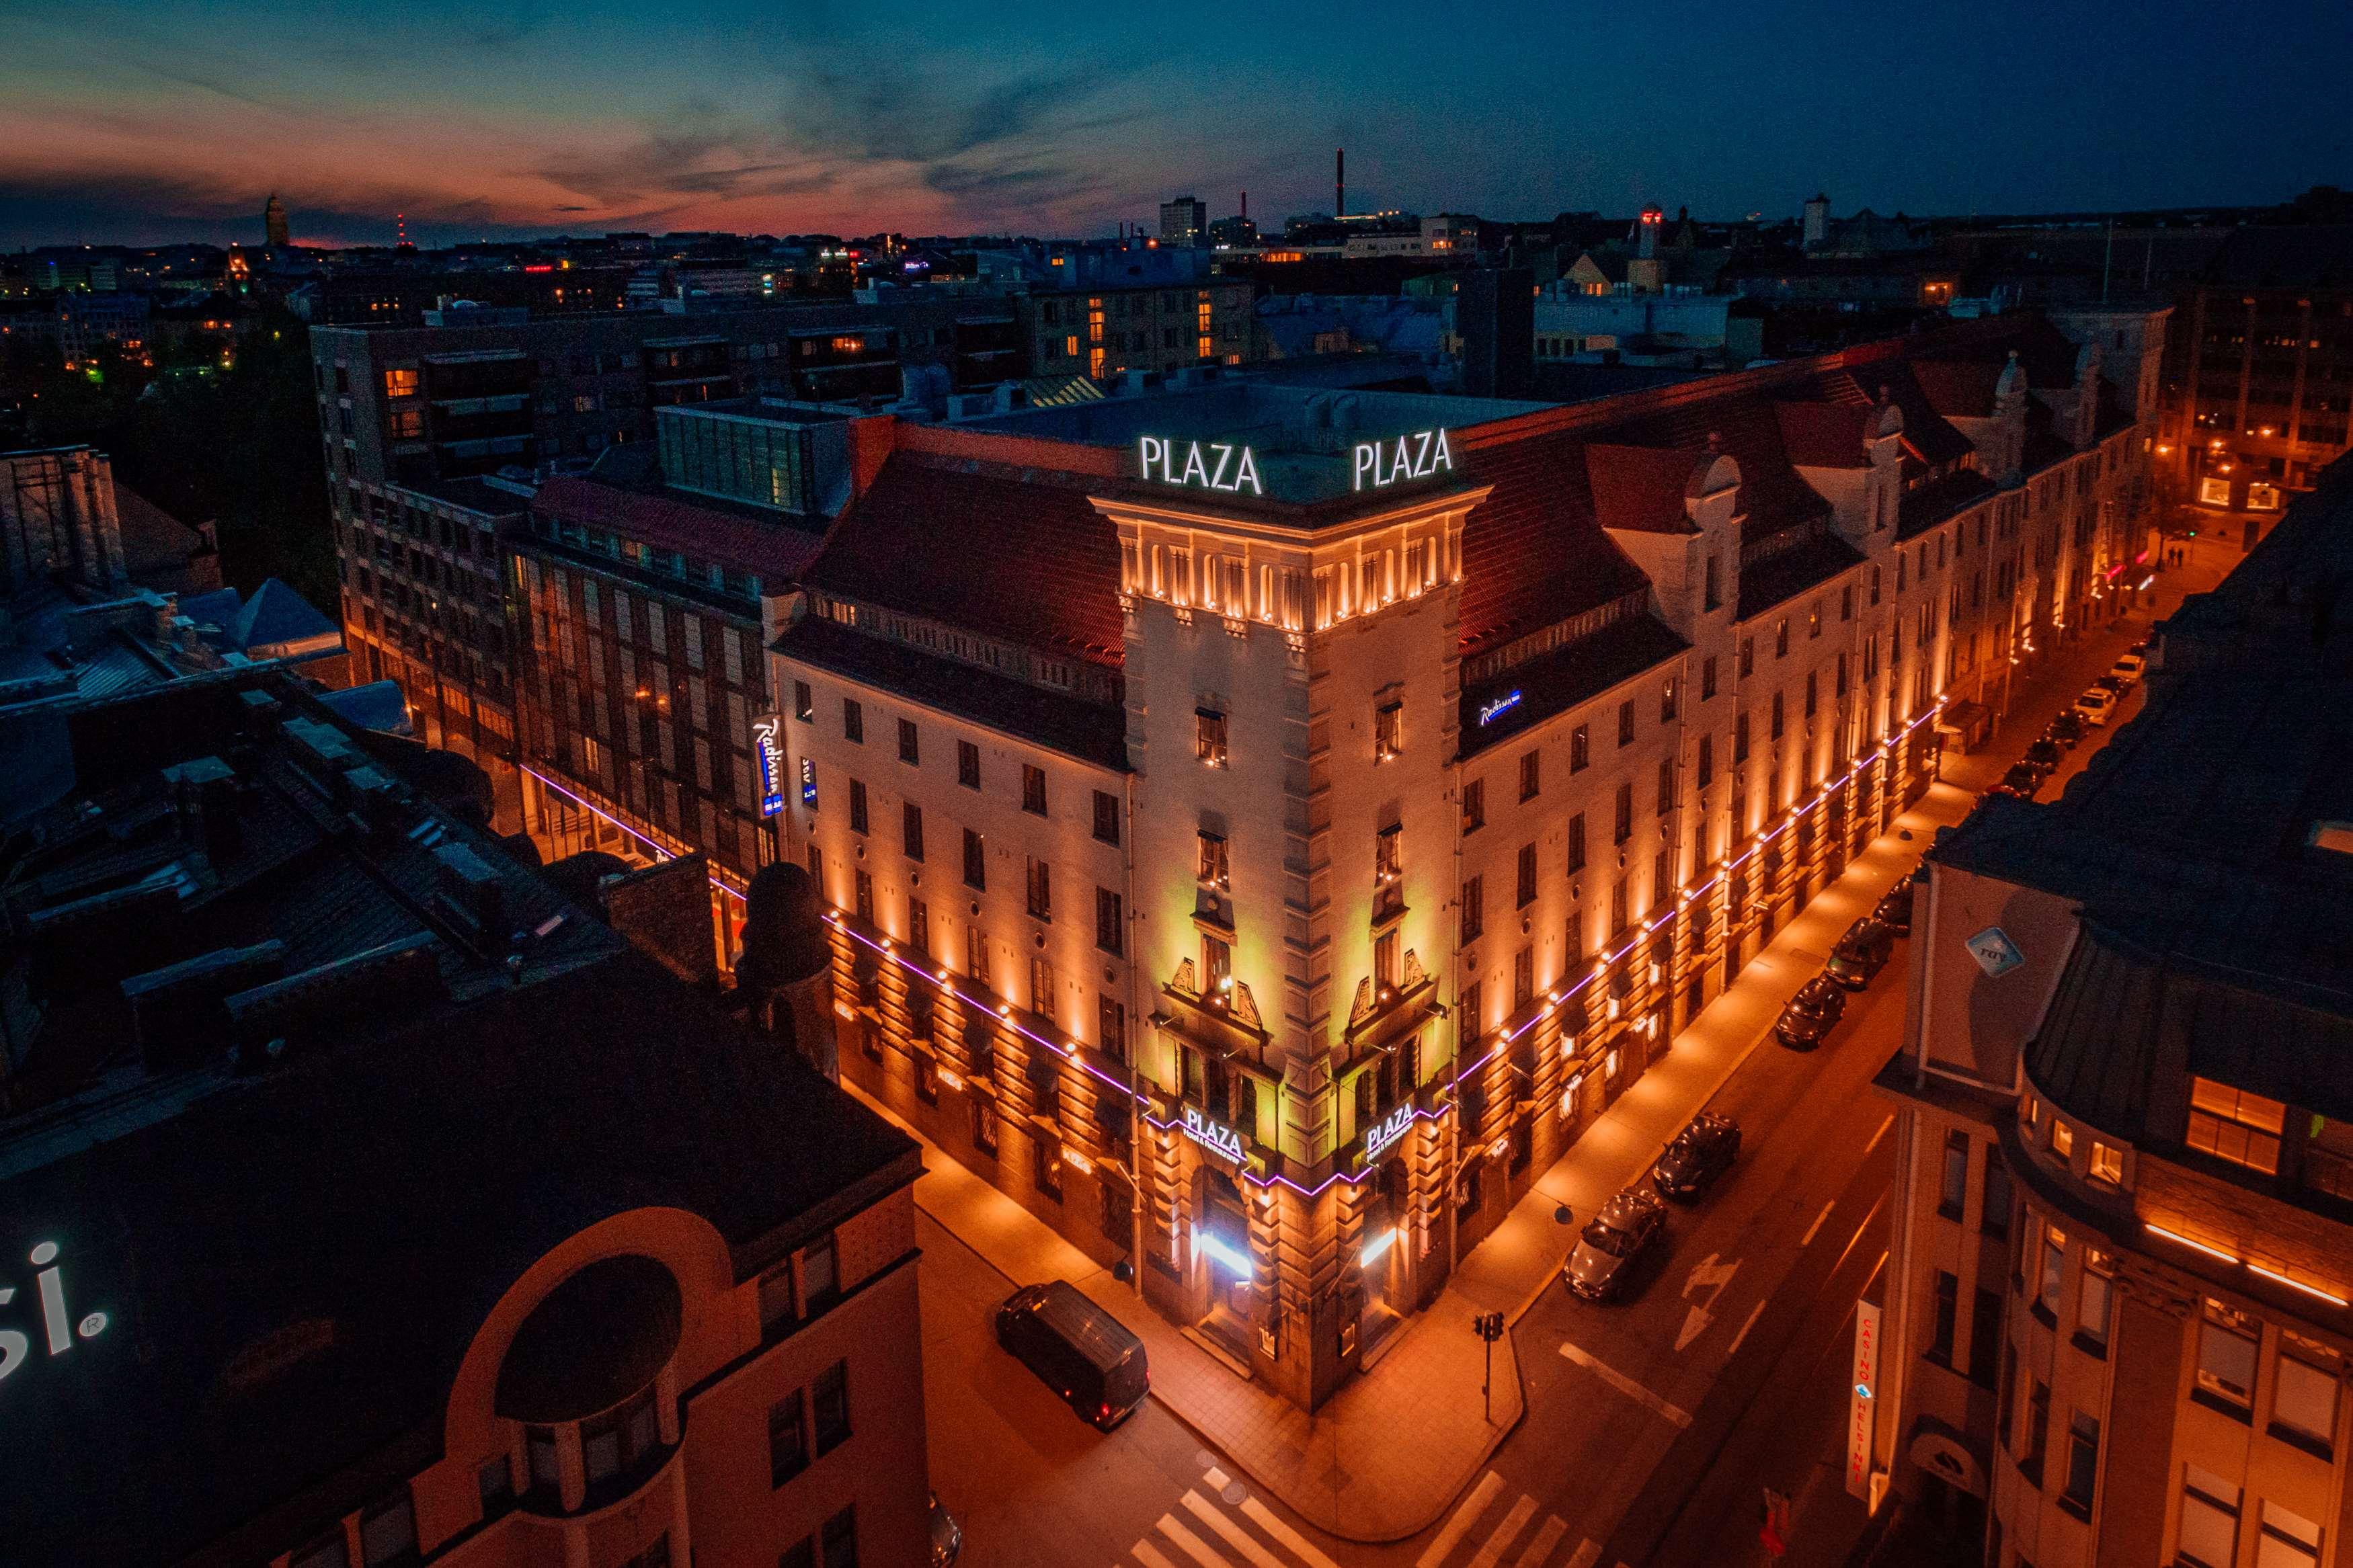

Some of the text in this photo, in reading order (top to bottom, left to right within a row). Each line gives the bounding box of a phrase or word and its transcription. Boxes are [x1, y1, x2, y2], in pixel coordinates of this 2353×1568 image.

[1141, 437, 1262, 495] PLAZA
[1355, 427, 1452, 491] PLAZA
[753, 718, 783, 796] Radisson
[1187, 1109, 1242, 1157] PLAZA
[1367, 1103, 1412, 1152] PLAZA
[1860, 1319, 1872, 1380] CASINO
[1853, 1402, 1866, 1484] HELSINKI
